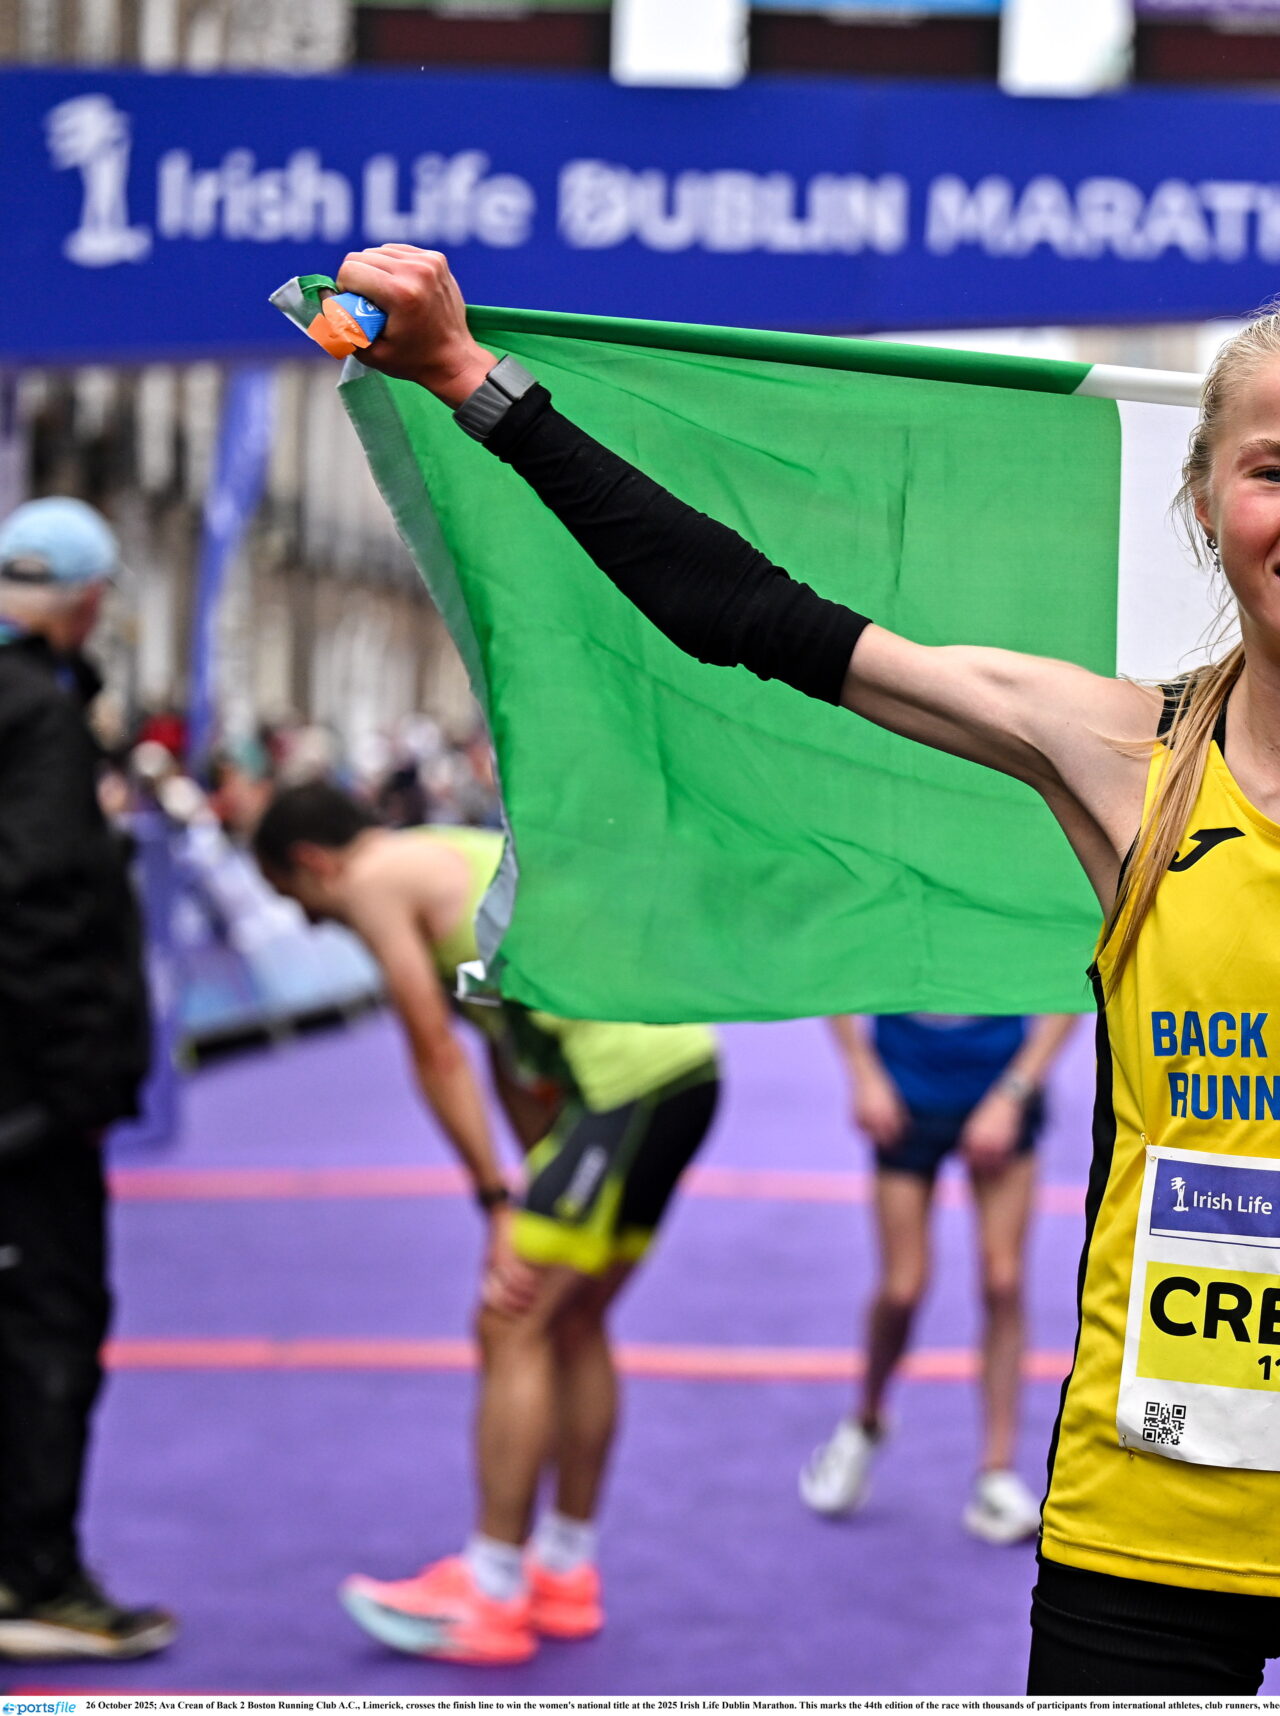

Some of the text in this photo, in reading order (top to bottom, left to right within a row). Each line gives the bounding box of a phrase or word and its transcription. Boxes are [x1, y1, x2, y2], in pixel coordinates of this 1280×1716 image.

[158, 149, 352, 241] Irish
[363, 151, 536, 247] Life
[558, 160, 909, 255] DUBLIN
[1151, 1010, 1268, 1058] BACK
[1193, 1190, 1273, 1215] Irish Life
